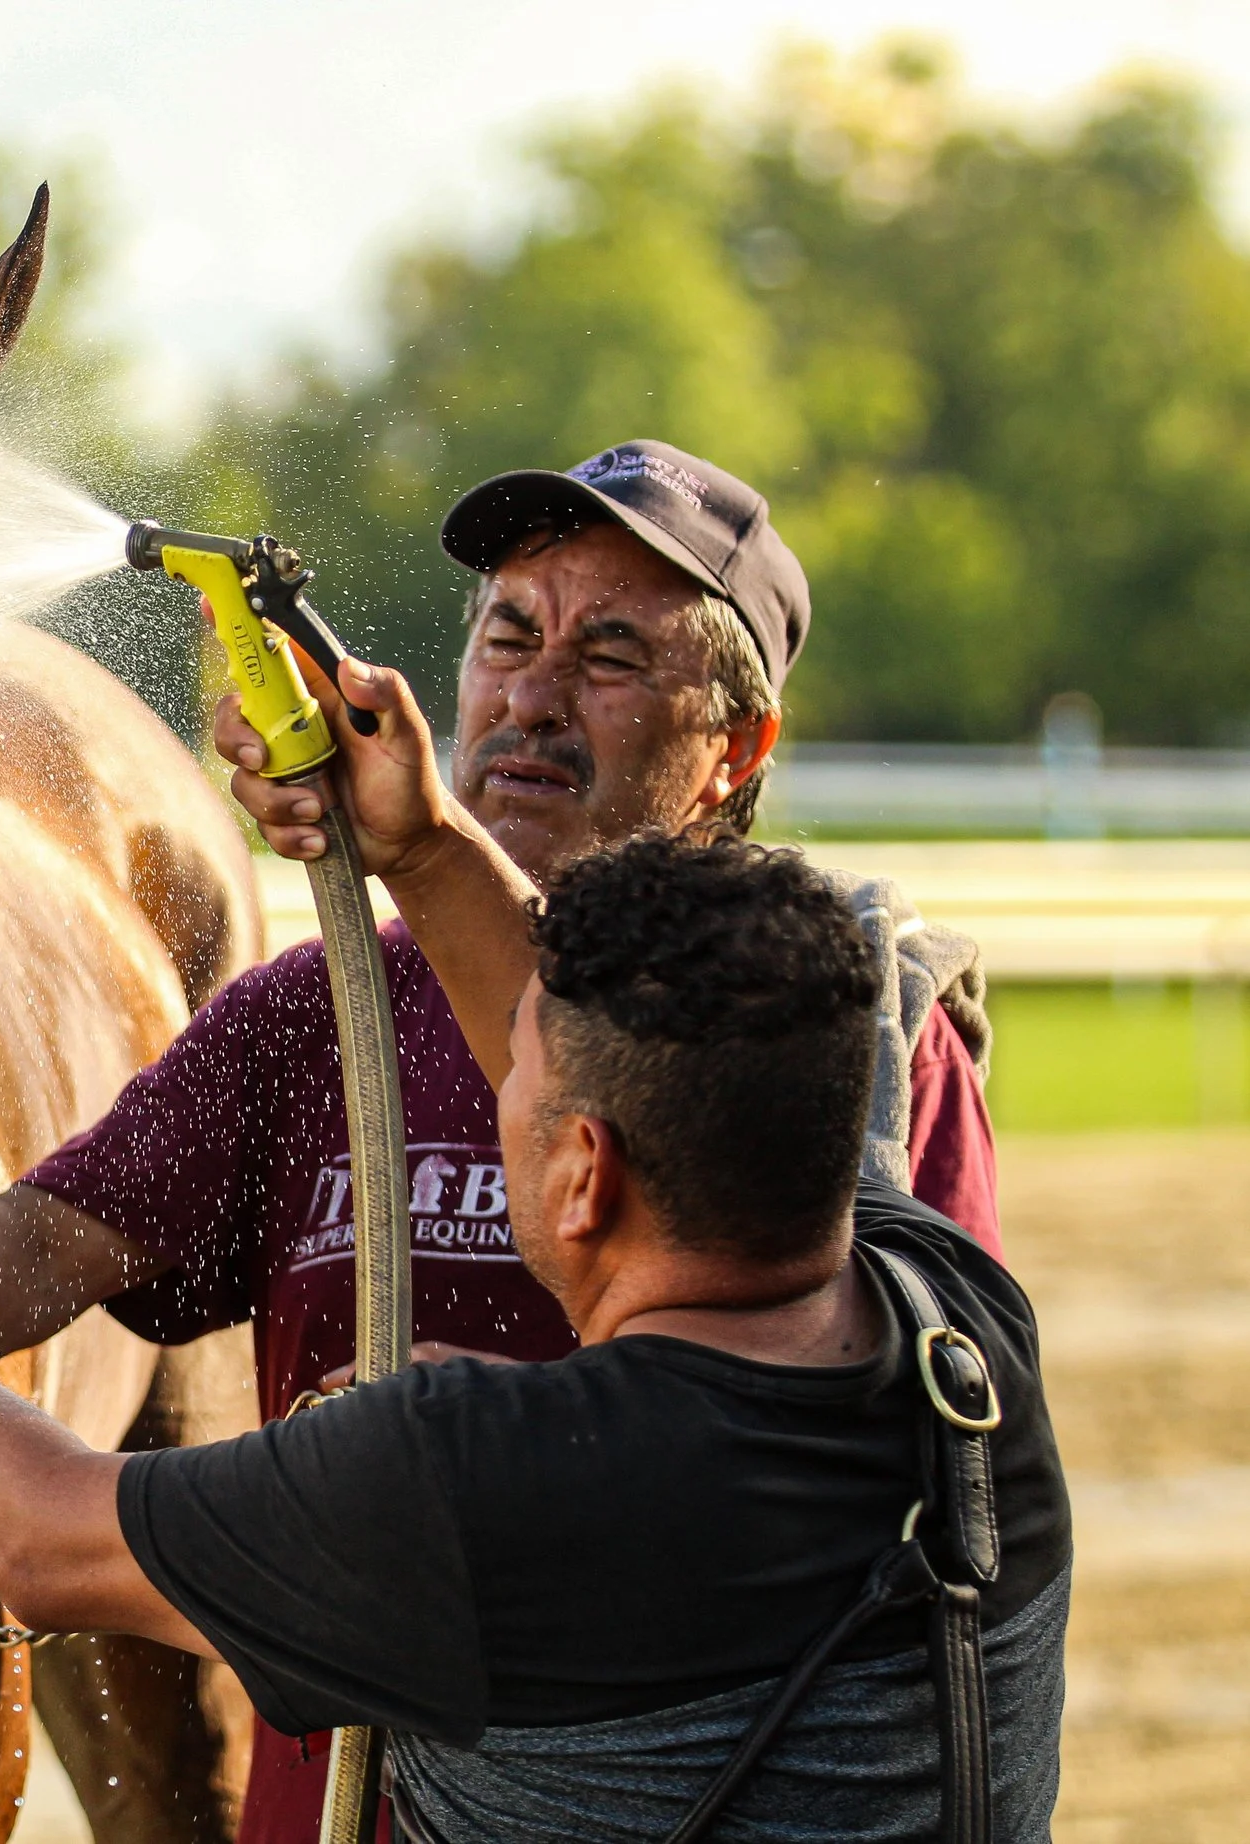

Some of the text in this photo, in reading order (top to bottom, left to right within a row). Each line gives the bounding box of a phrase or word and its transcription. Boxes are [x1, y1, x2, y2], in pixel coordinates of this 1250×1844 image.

[231, 617, 265, 688] DIXON
[295, 1218, 517, 1260] SUPER EQUIN
